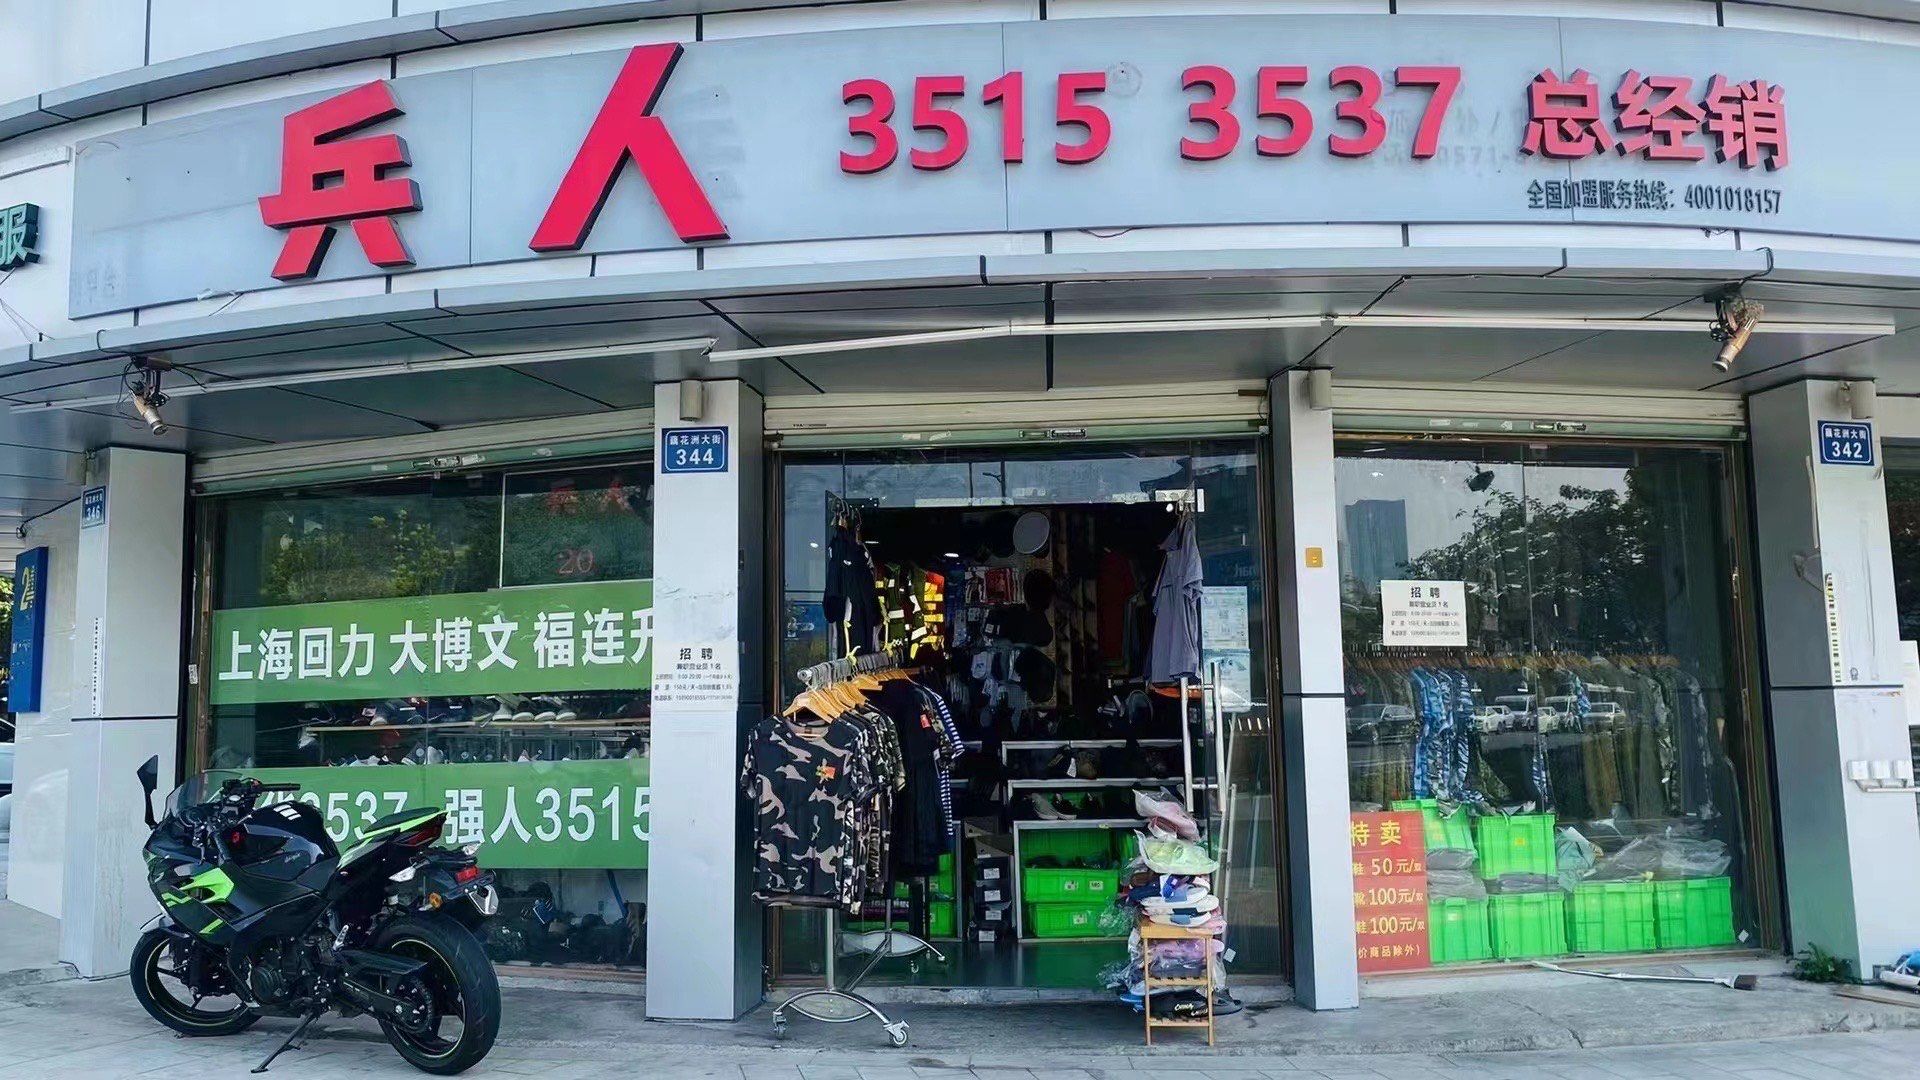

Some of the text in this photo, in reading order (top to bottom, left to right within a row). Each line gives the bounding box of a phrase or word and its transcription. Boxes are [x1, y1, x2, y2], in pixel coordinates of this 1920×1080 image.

[258, 44, 732, 283] 兵人
[839, 71, 1112, 175] 3515
[1180, 65, 1462, 162] 3537
[1520, 67, 1788, 172] 总经销
[1527, 178, 1782, 215] 全国加盟服务热线： 4001018157
[676, 448, 714, 465] 344
[1832, 441, 1863, 458] 342
[218, 623, 375, 681] 上海回力
[389, 614, 519, 673] 大博文
[680, 647, 713, 660] 招聘
